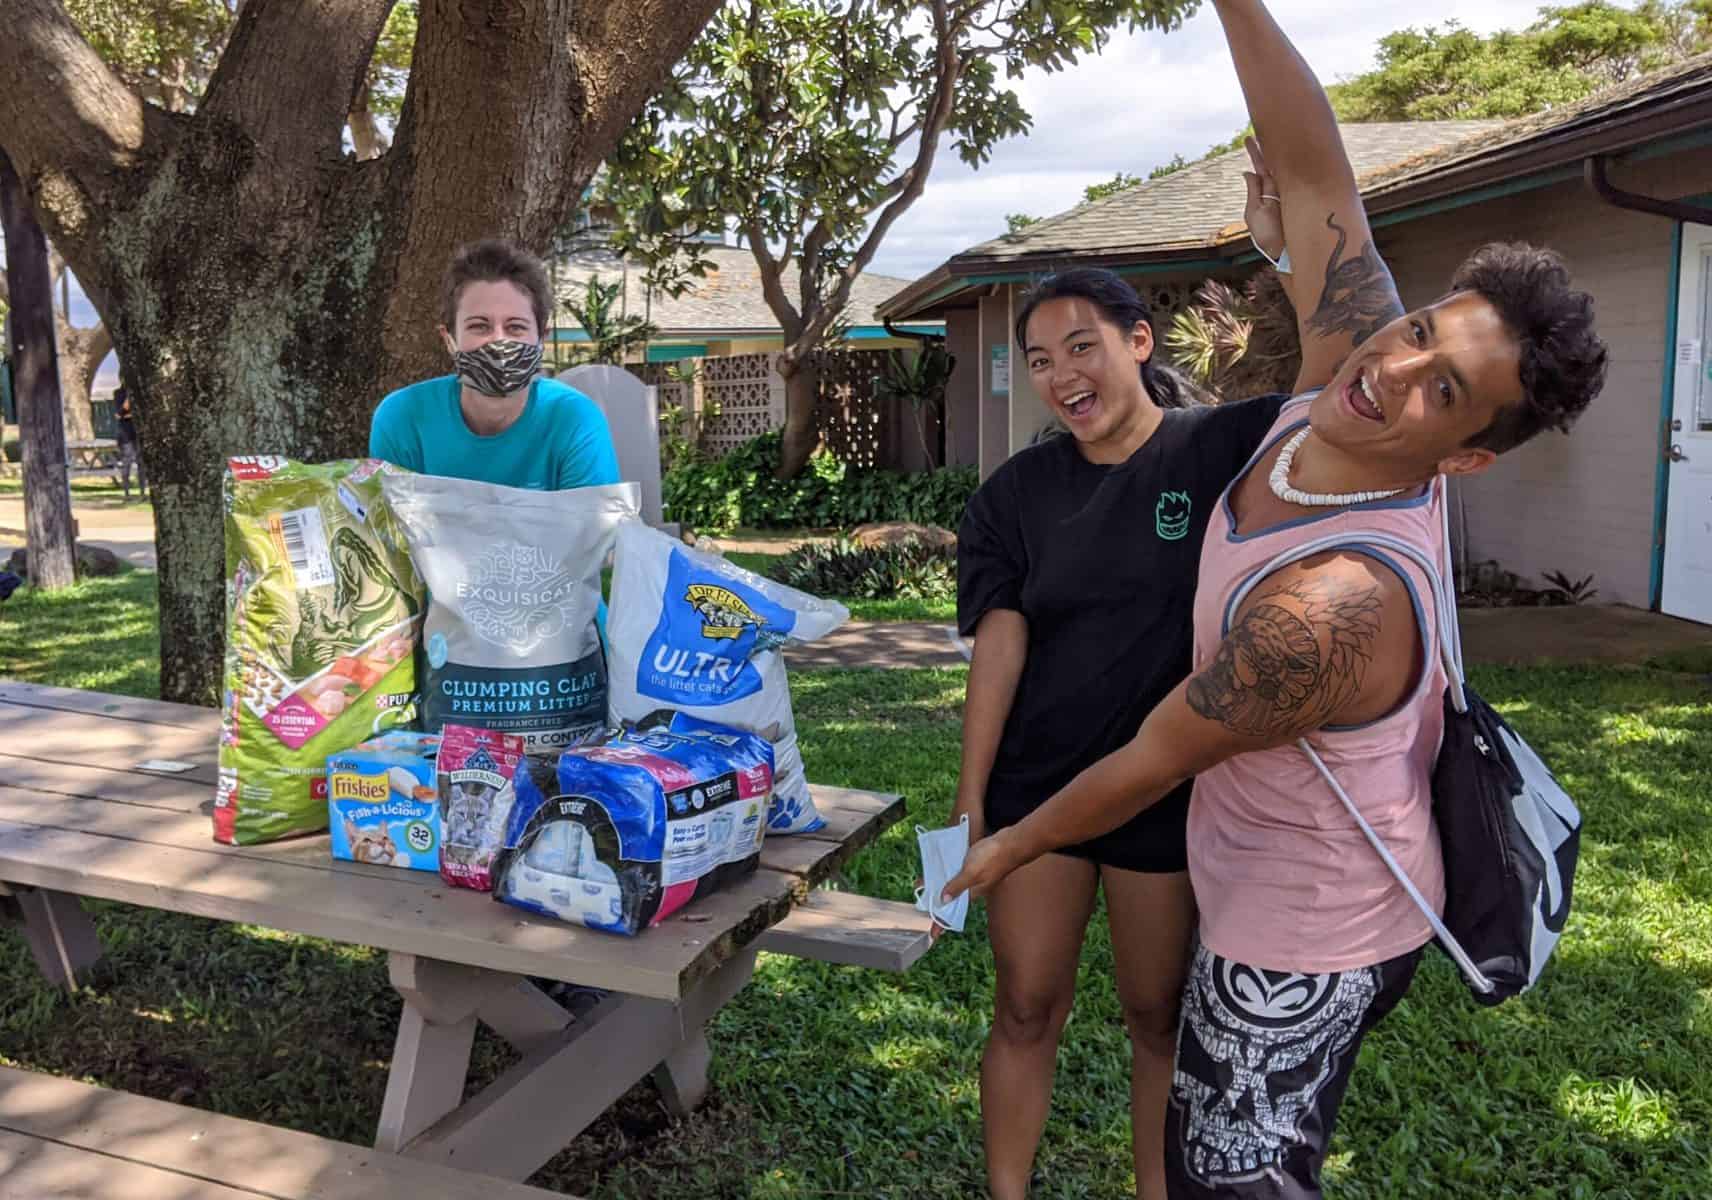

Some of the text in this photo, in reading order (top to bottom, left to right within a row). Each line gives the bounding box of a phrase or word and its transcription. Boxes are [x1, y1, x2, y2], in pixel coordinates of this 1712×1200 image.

[456, 582, 574, 606] EXQUISICAT
[442, 671, 597, 697] CLUMPING CLAY
[651, 674, 666, 685] the
[452, 699, 531, 713] PREMIUM
[335, 777, 386, 799] Friskies
[411, 826, 429, 842] 32
